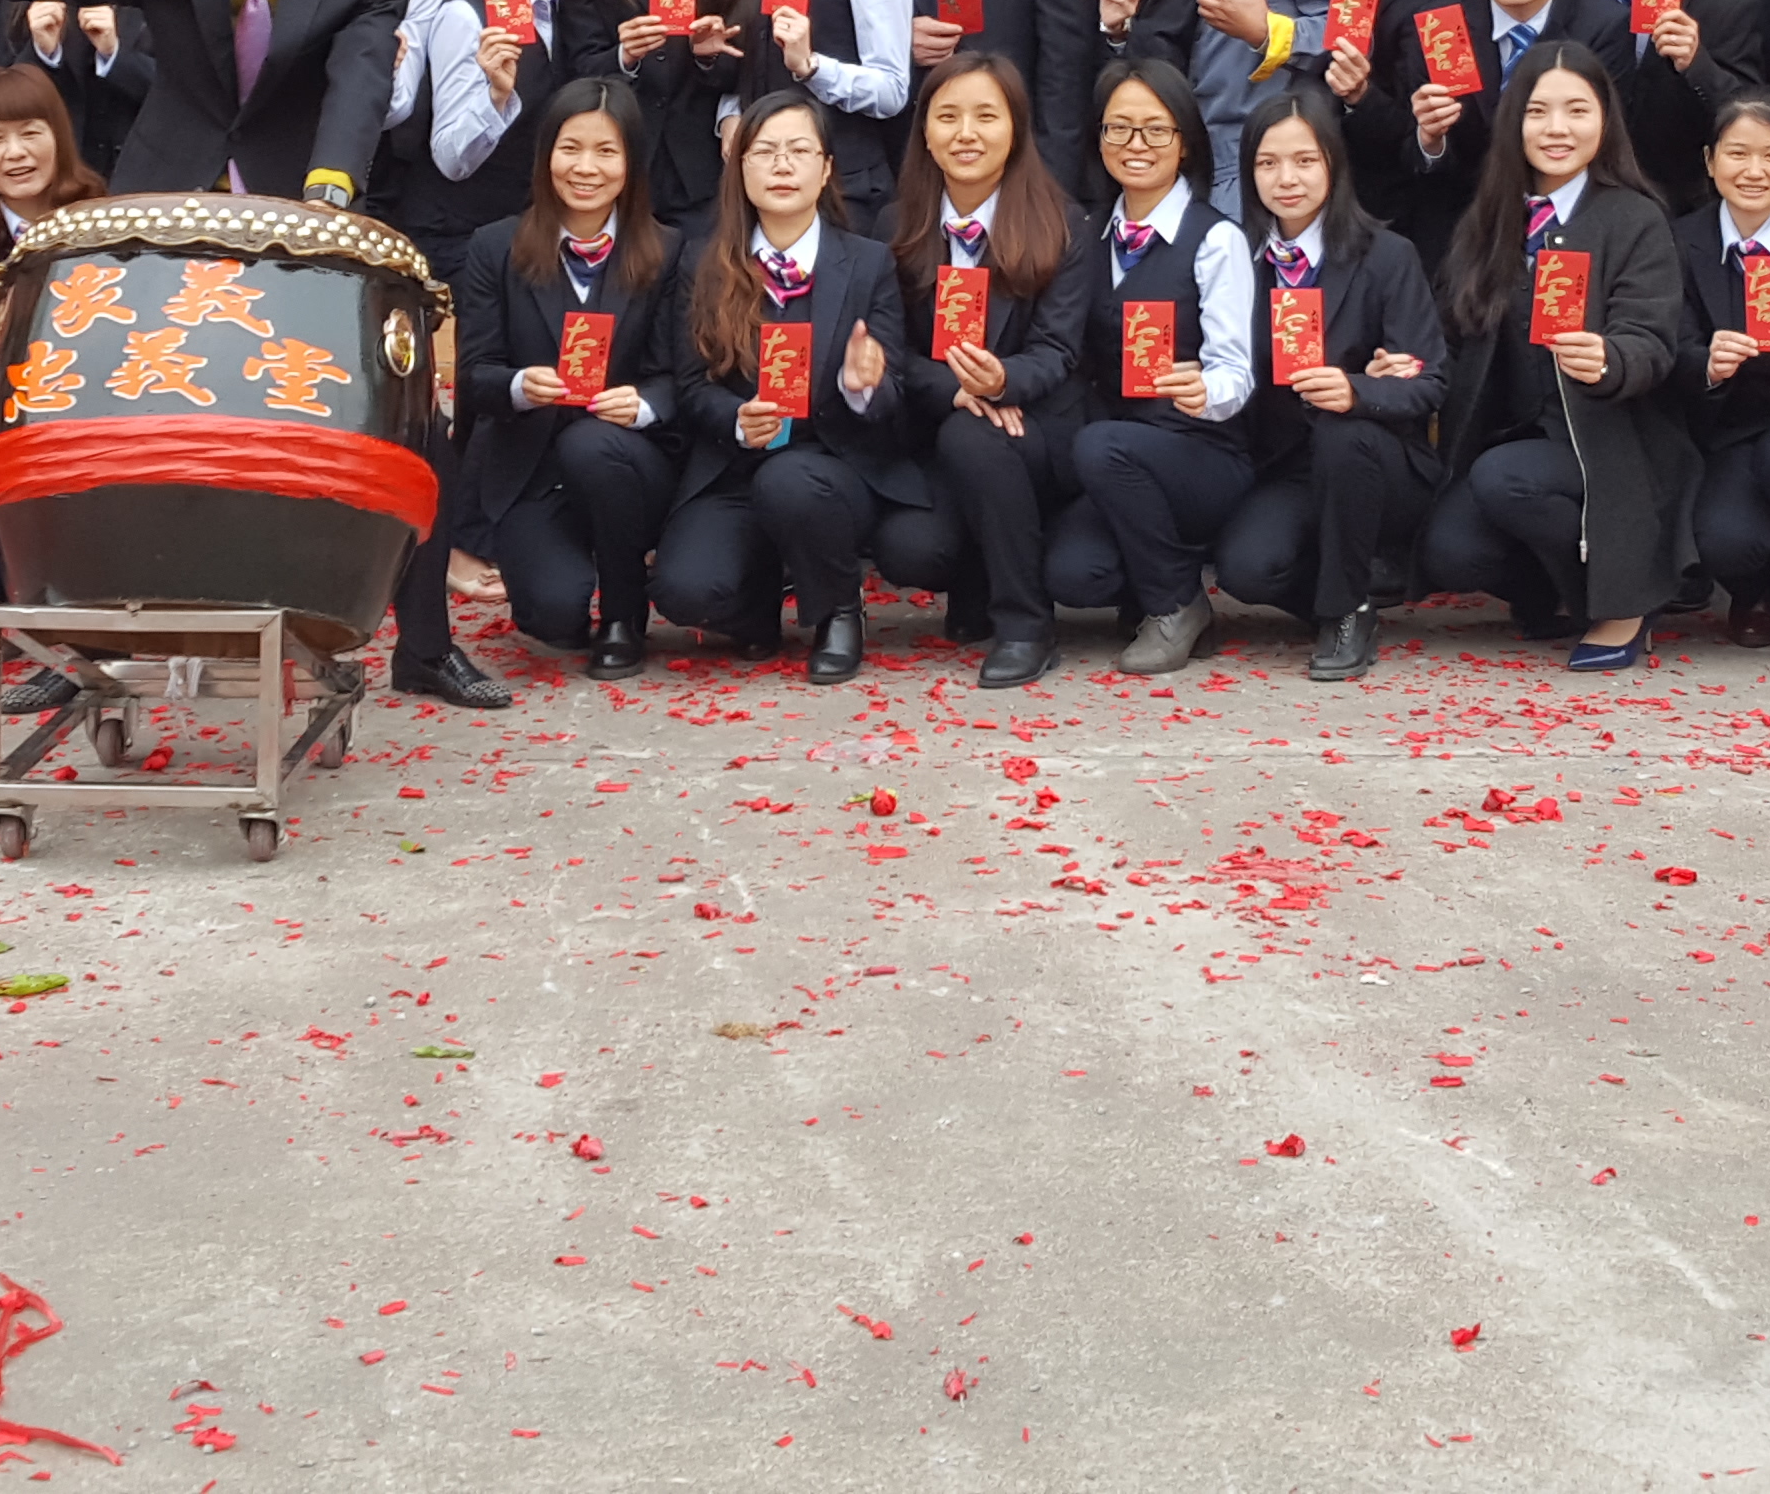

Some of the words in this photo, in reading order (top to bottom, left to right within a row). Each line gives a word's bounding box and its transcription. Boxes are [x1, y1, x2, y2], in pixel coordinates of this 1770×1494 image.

[1418, 15, 1454, 73] 大吉
[936, 270, 973, 333] 大吉
[1535, 255, 1573, 317] 大吉
[562, 317, 597, 378] 大吉
[1126, 305, 1161, 367] 大吉
[1273, 292, 1308, 355] 大吉
[762, 329, 797, 389] 大吉
